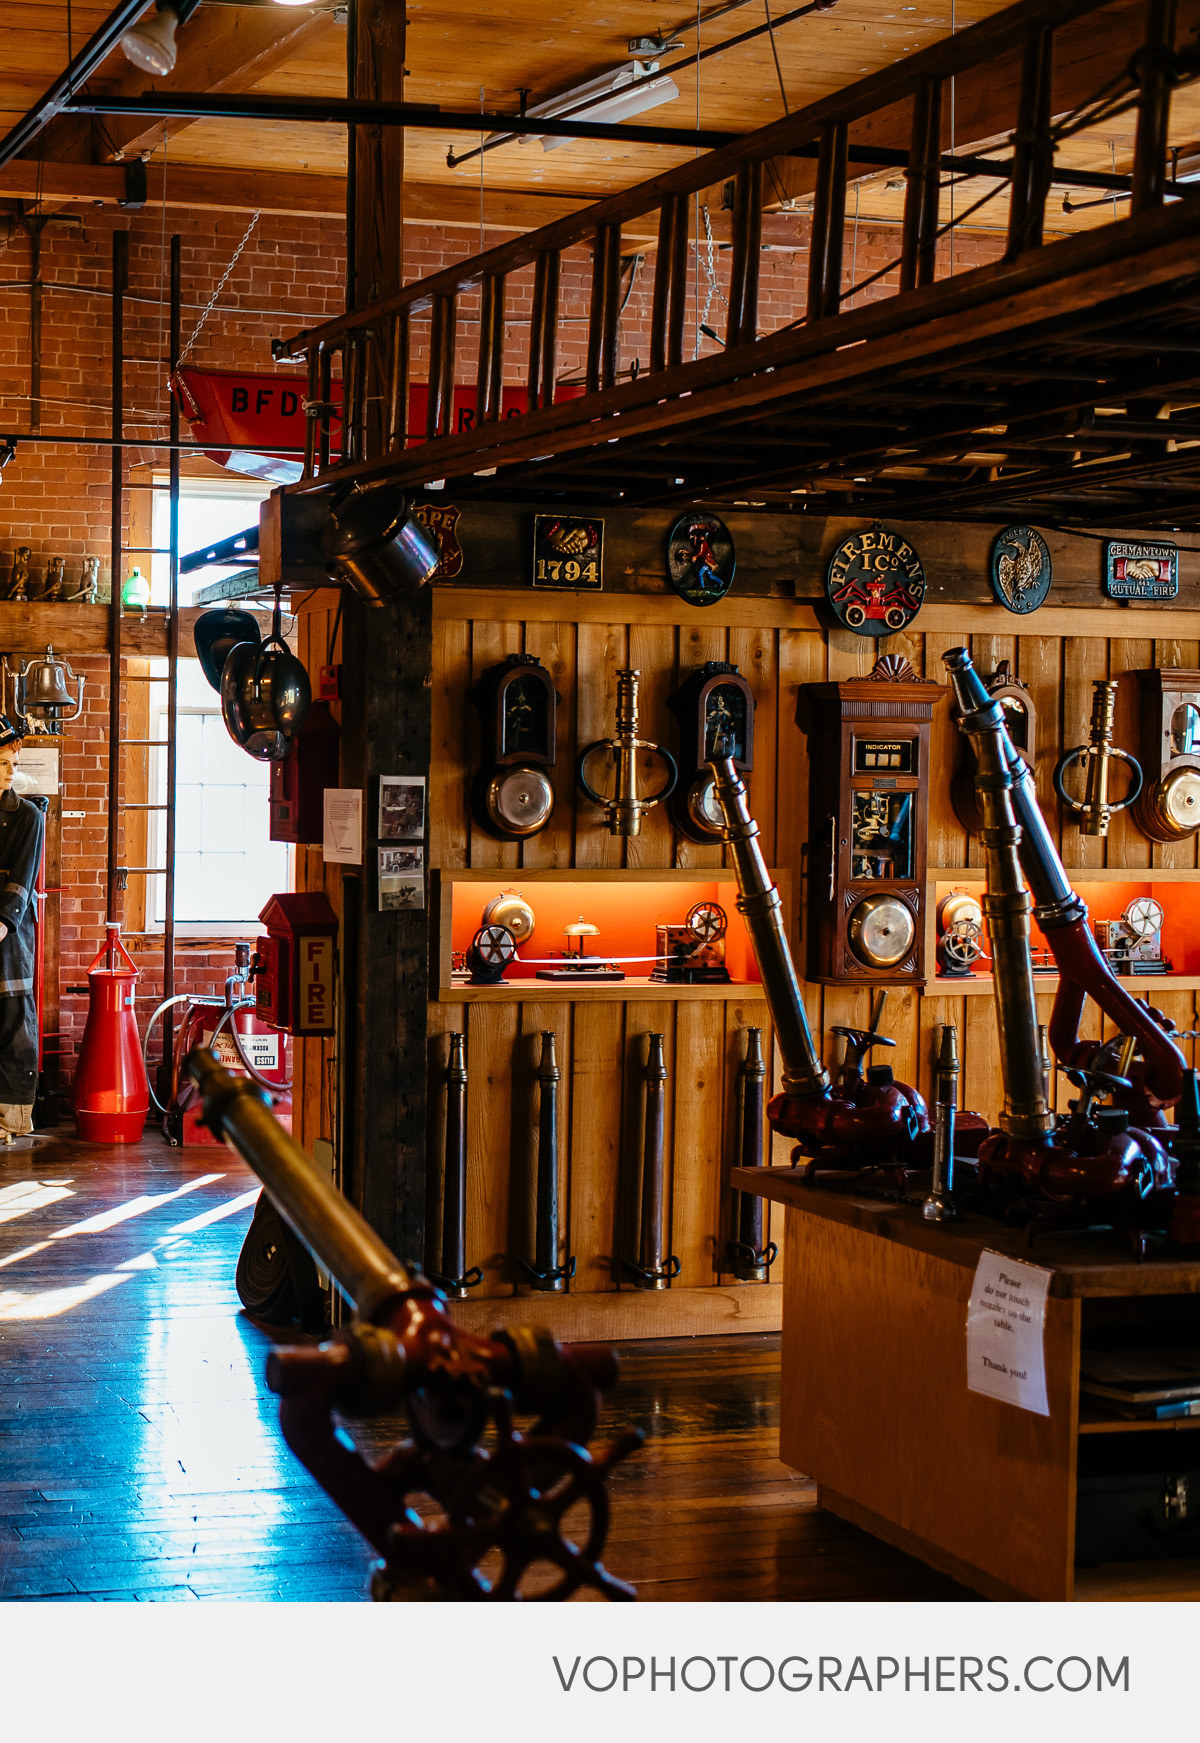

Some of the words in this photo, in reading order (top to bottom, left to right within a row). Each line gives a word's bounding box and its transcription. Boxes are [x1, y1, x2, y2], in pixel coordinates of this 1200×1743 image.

[232, 388, 298, 417] BFD
[417, 511, 455, 531] OPE
[1109, 545, 1177, 557] GERMANTOWN
[537, 559, 599, 582] 1794
[830, 532, 923, 598] FIREMEN'S
[1109, 584, 1147, 596] MUTUAL
[1153, 586, 1175, 596] FIRE
[307, 941, 325, 1024] FIRE
[256, 1056, 274, 1066] BLISS
[999, 1272, 1022, 1289] Please
[984, 1284, 994, 1295] do
[995, 1290, 1007, 1299] not
[1008, 1294, 1030, 1307] touch
[979, 1299, 1006, 1314] nozzles
[1019, 1311, 1031, 1323] the
[993, 1319, 1014, 1332] table.
[982, 1356, 1008, 1373] Thank
[1009, 1369, 1027, 1380] you!
